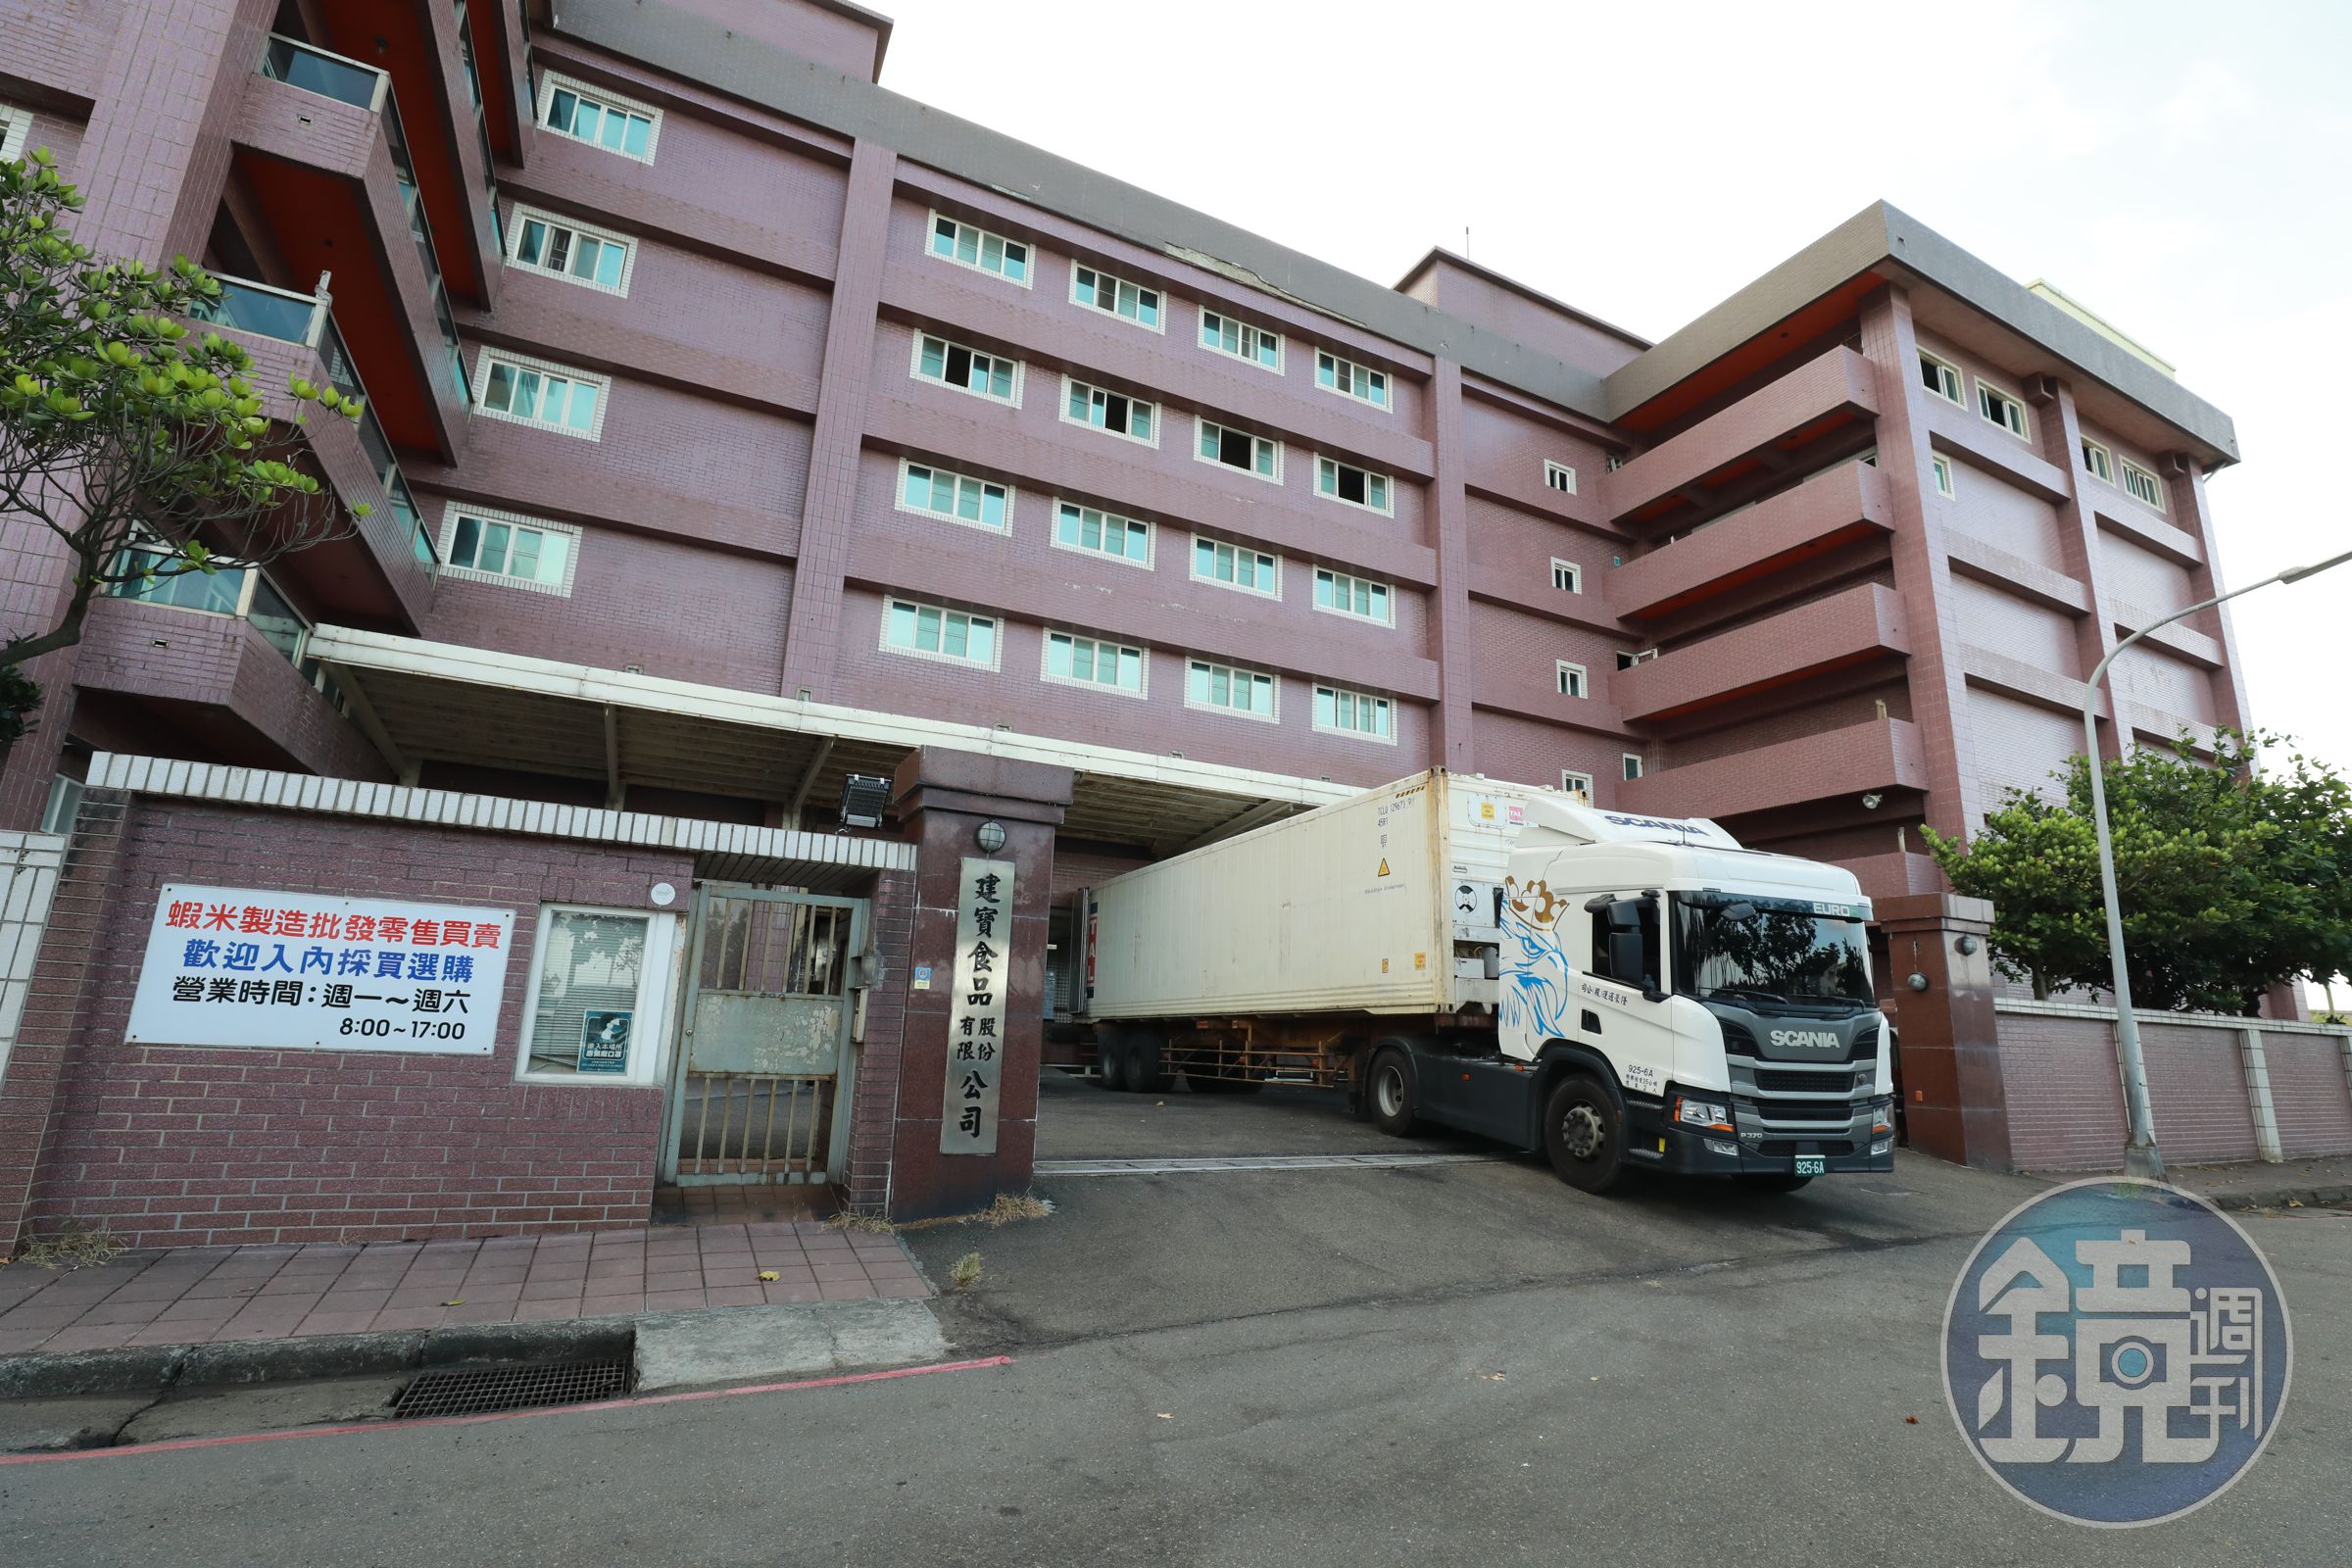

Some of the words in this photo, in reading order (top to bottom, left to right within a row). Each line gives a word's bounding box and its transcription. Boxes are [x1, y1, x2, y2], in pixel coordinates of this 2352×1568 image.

[1604, 815, 1710, 836] SCANIA
[1813, 903, 1850, 917] EURO
[166, 900, 502, 950] 蝦米製造批發零售買賣
[967, 872, 1001, 1006] 建寶食品
[182, 938, 474, 984] 歡迎入內採買選購
[1770, 1030, 1840, 1048] SCANIA
[1629, 1064, 1653, 1078] 925-6A
[1796, 1161, 1825, 1174] 925-6A
